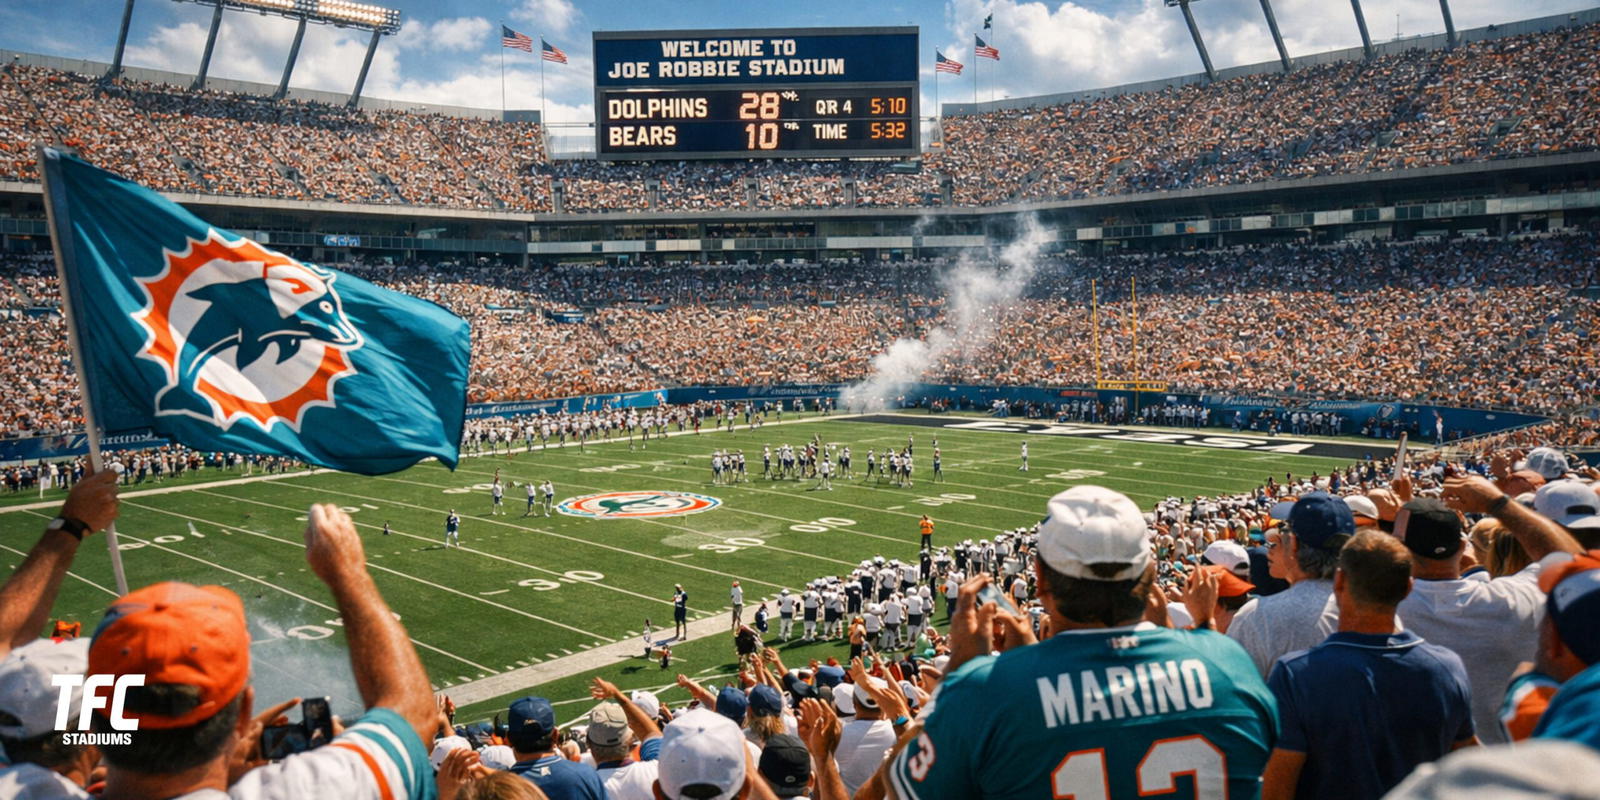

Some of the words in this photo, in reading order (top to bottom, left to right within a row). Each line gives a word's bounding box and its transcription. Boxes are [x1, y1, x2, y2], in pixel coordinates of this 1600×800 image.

[661, 39, 764, 58] WELCOME
[770, 39, 797, 56] TO
[608, 61, 650, 78] JOE
[658, 60, 740, 77] ROBBIE
[749, 58, 845, 76] STADIUM
[608, 98, 708, 119] DOLPHINS
[739, 92, 780, 120] 28
[843, 99, 853, 115] 4
[609, 126, 677, 147] BEARS
[745, 122, 779, 150] 10
[813, 124, 847, 139] TIME
[871, 122, 906, 139] 5:32
[1036, 658, 1214, 729] MARINO
